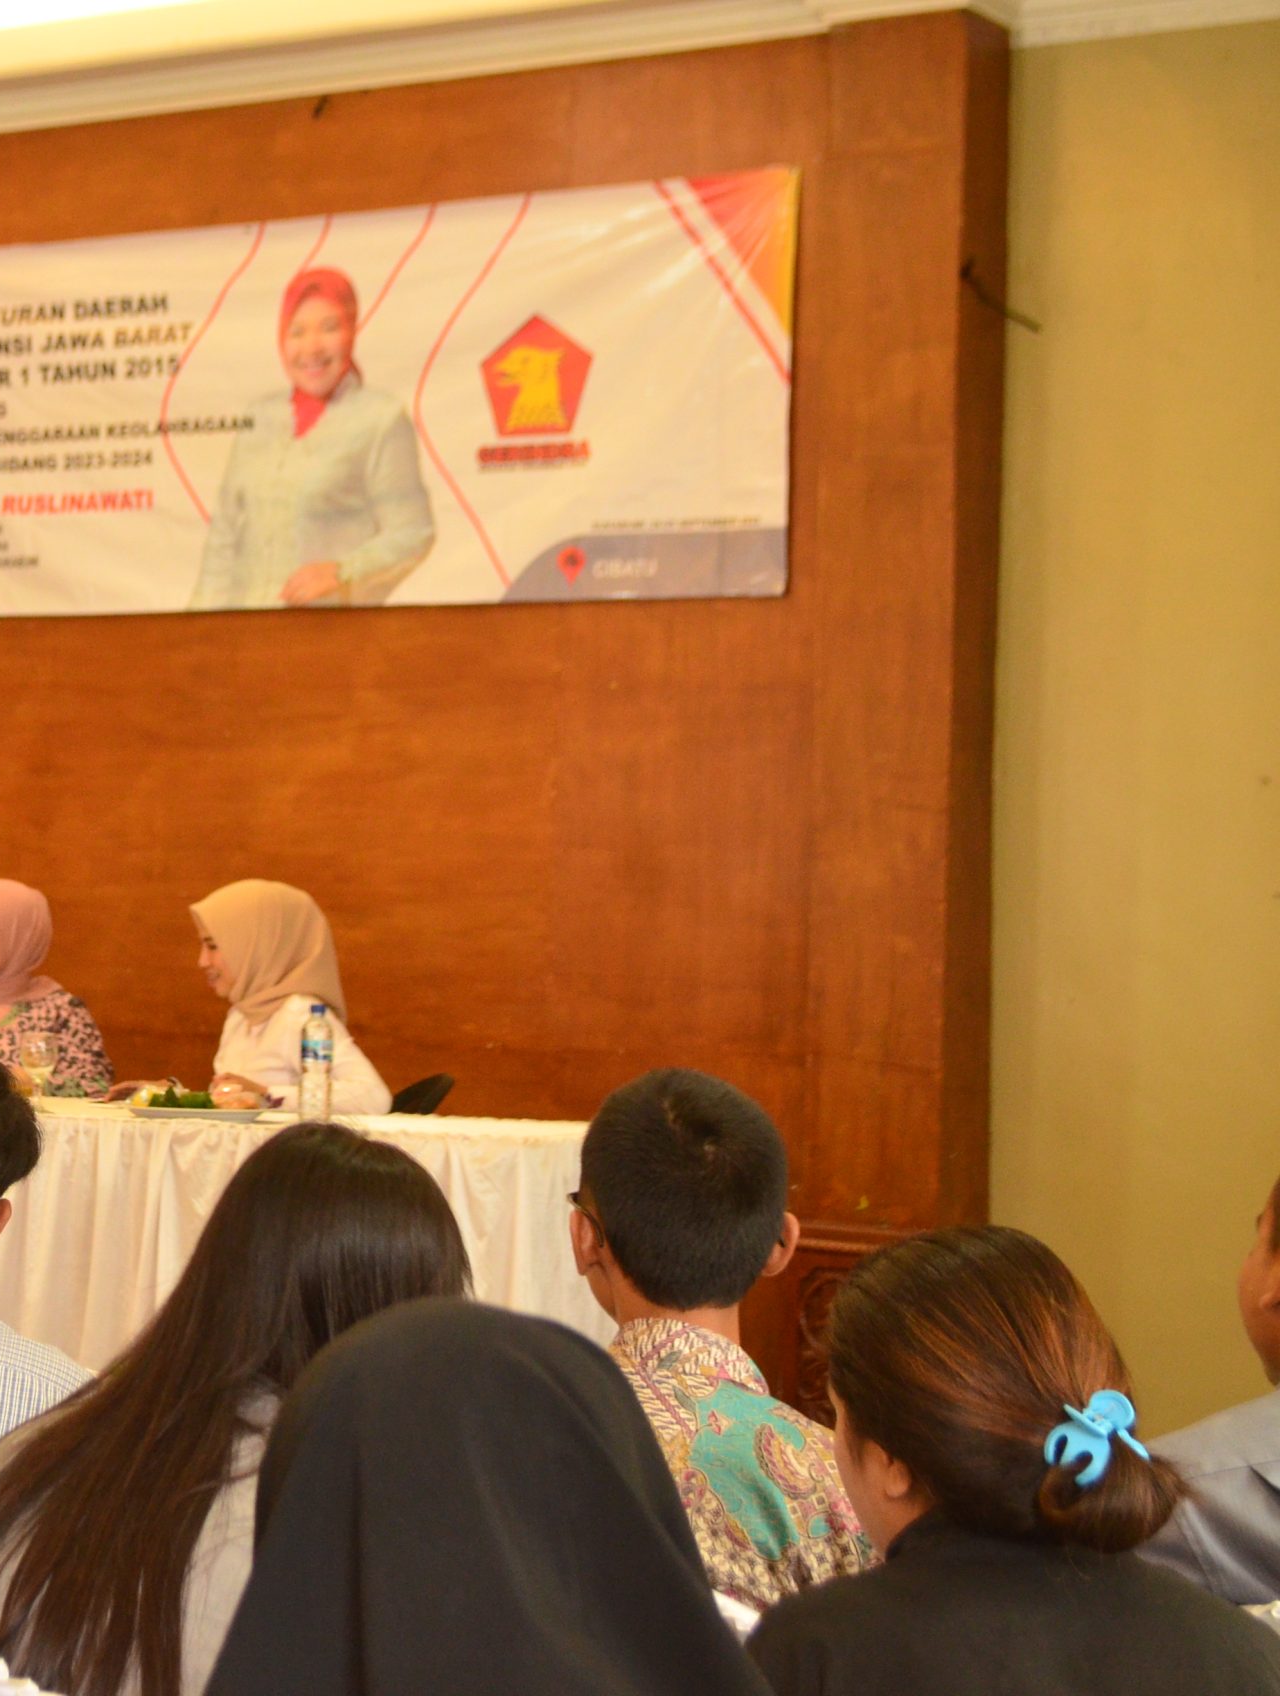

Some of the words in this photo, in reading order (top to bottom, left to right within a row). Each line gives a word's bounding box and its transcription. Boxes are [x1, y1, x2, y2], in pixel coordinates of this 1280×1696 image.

[73, 294, 169, 321] DAERAH
[41, 330, 106, 354] JAWA
[114, 322, 194, 348] BARAT
[21, 367, 30, 386] 1
[39, 359, 117, 384] TAHUN
[1, 489, 154, 516] RUSLINAWATI
